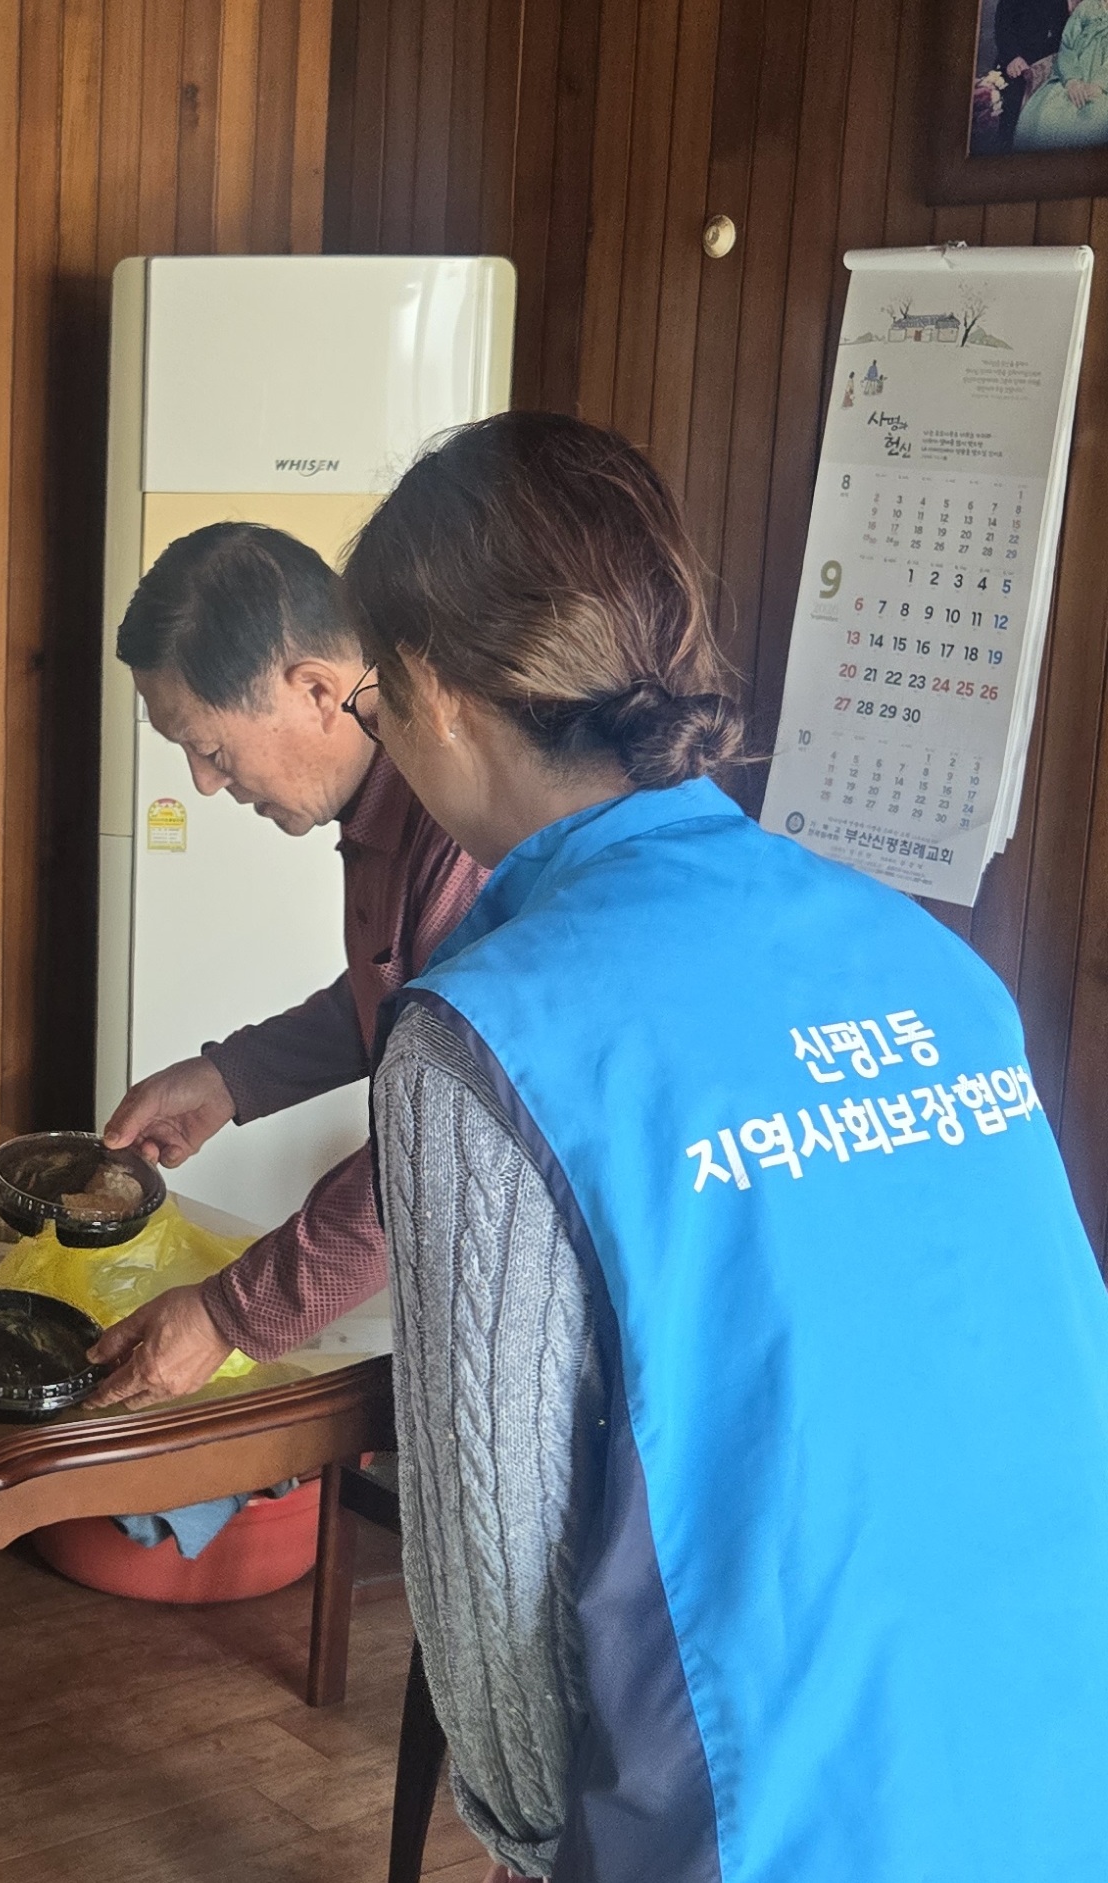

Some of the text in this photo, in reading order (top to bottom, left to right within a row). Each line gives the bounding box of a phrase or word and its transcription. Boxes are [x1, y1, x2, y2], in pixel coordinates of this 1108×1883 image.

[884, 432, 912, 458] 헌신
[275, 459, 340, 471] WHISEN
[842, 475, 850, 489] 8
[893, 509, 902, 518] 10
[918, 511, 924, 520] 11
[940, 514, 949, 522] 12
[964, 516, 973, 524] 13
[988, 518, 996, 526] 14
[1012, 520, 1021, 528] 15
[897, 496, 902, 504] 3
[920, 498, 925, 506] 4
[944, 499, 949, 508] 5
[968, 501, 973, 510] 6
[992, 503, 998, 511] 7
[1016, 505, 1021, 514] 8
[891, 523, 899, 532] 17
[915, 526, 923, 534] 18
[938, 528, 946, 537] 19
[961, 530, 972, 539] 20
[985, 533, 994, 541] 21
[1009, 535, 1019, 544] 22
[911, 540, 1017, 559] 25 26 27 28 29
[819, 560, 842, 599] 9
[908, 569, 1011, 594] 1 2 3 4 5
[855, 598, 864, 611] 6
[878, 601, 887, 614] 7
[900, 603, 909, 617] 8
[924, 606, 934, 620] 9
[945, 609, 960, 623] 10
[972, 612, 982, 627] 11
[994, 615, 1008, 630] 12
[846, 631, 1002, 665] 13 14 15 16 17 18 19
[839, 664, 998, 700] 20 21 22 23 24 25 26
[834, 696, 921, 723] 27 28 29 30
[798, 730, 811, 745] 10
[853, 755, 859, 764] 5
[876, 759, 882, 767] 6
[923, 768, 929, 776] 8
[947, 772, 953, 781] 9
[970, 776, 979, 785] 10
[926, 754, 980, 771] 1 2 3
[847, 782, 855, 790] 19
[868, 786, 879, 795] 20
[892, 791, 900, 799] 21
[915, 795, 926, 804] 22
[939, 800, 949, 809] 23
[962, 804, 974, 813] 24
[850, 769, 858, 777] 12
[872, 773, 881, 781] 13
[895, 777, 903, 785] 14
[919, 781, 928, 790] 15
[943, 786, 952, 795] 16
[968, 791, 976, 799] 17
[843, 795, 853, 804] 26
[866, 800, 876, 808] 27
[888, 804, 899, 813] 28
[912, 809, 923, 817] 29
[935, 813, 946, 823] 30
[960, 818, 970, 827] 31
[844, 828, 954, 865] 부산신평침례교회
[790, 1008, 940, 1084] 신평1동
